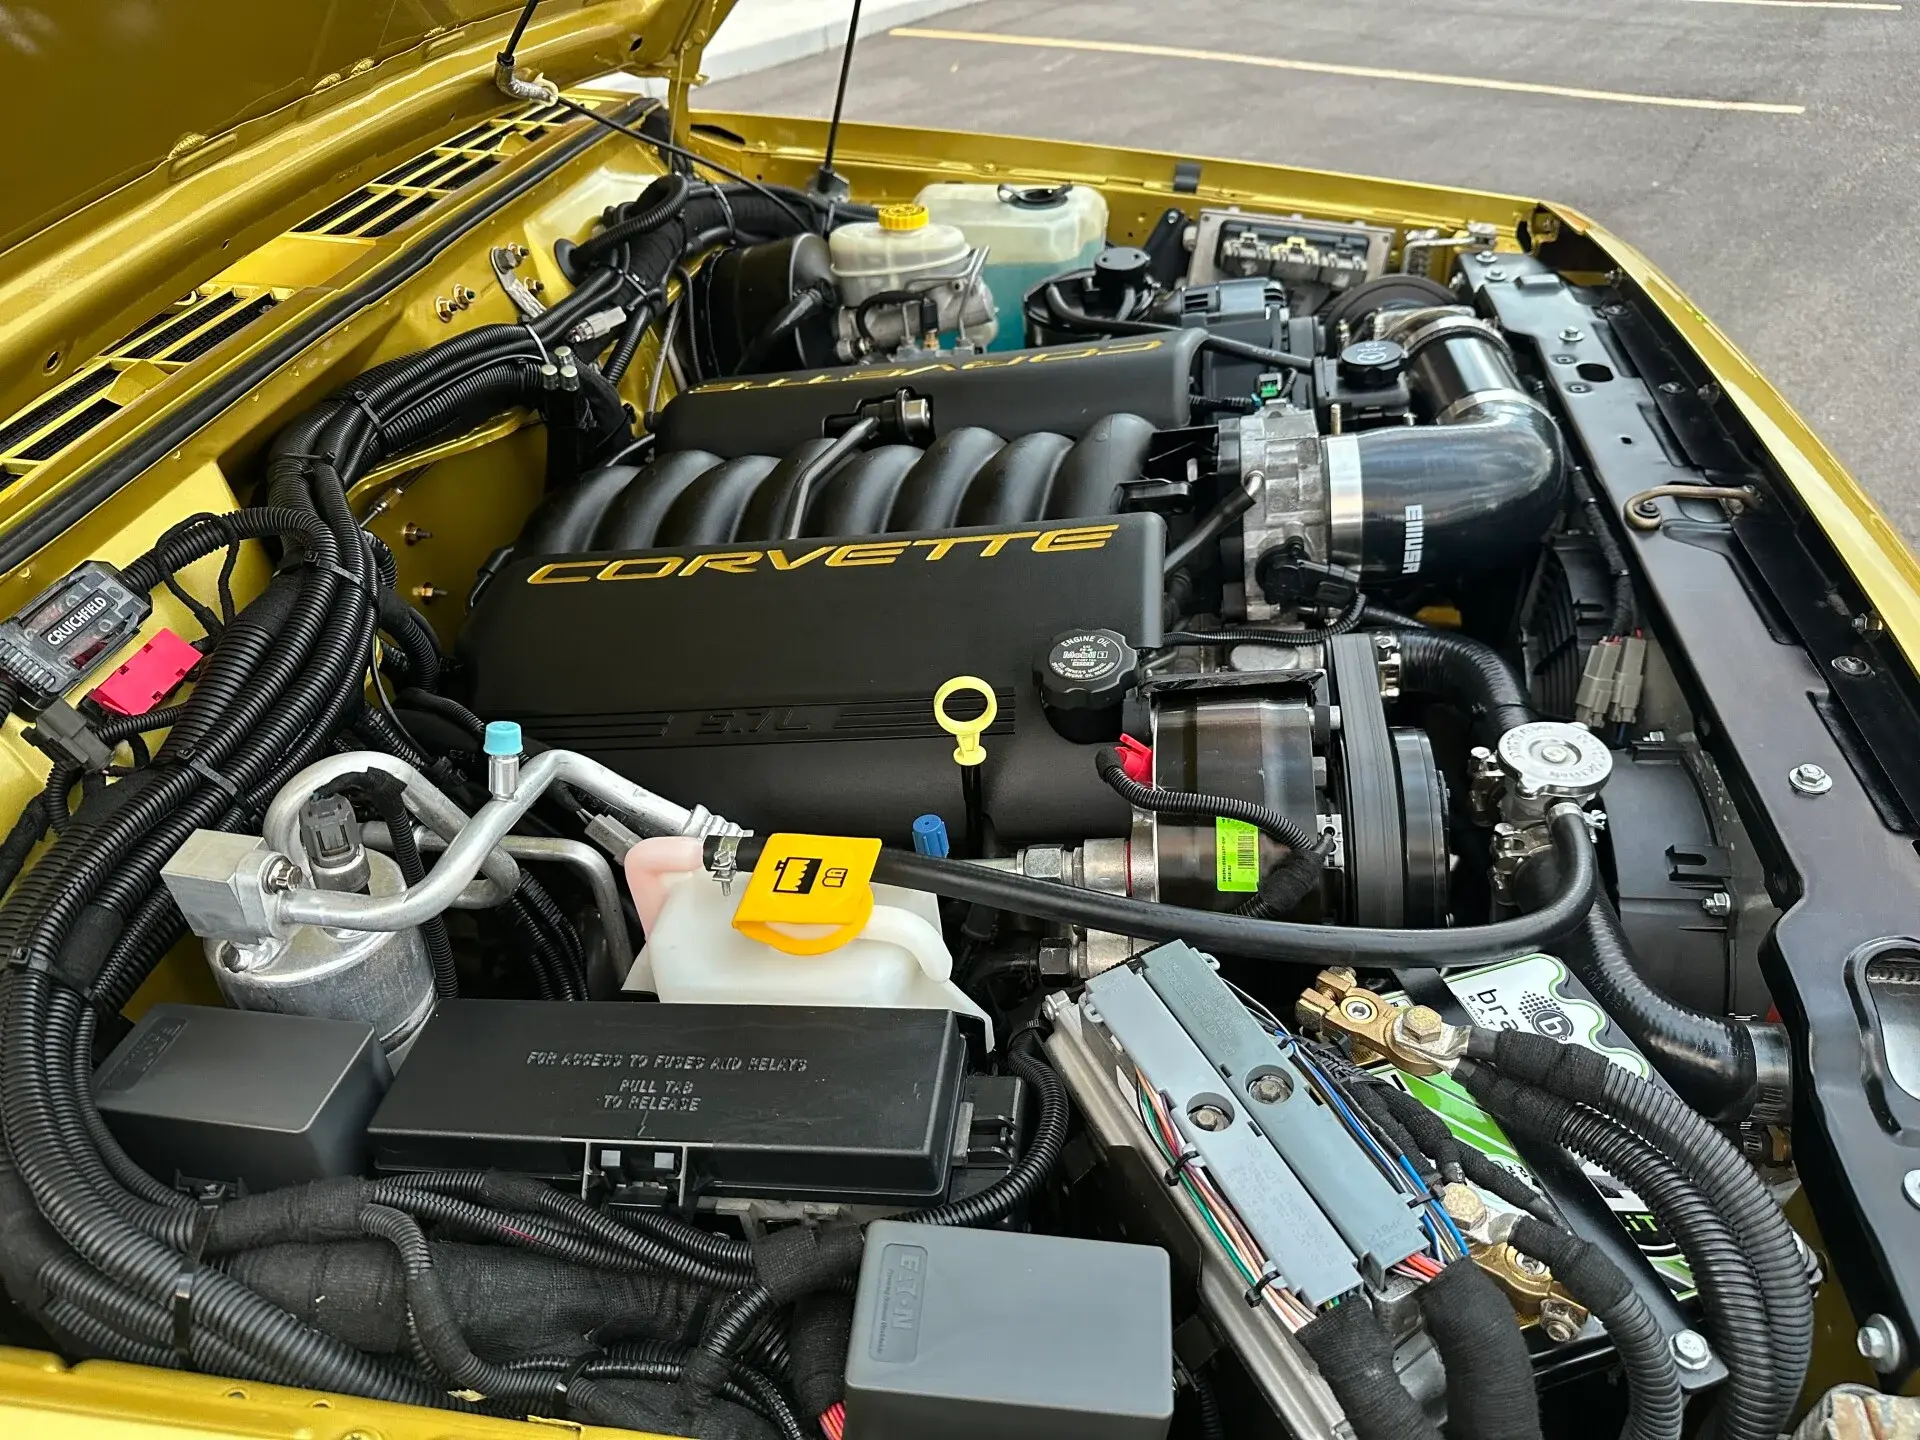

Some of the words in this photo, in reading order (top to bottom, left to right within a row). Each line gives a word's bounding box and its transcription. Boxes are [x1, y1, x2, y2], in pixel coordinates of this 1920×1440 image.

[526, 524, 1119, 585] CORVETTE
[47, 596, 107, 645] CRUTCHFIELD
[1060, 635, 1096, 647] ENGINE
[1096, 638, 1111, 647] OIL
[1063, 651, 1096, 659] Mobil
[696, 709, 810, 734] 5.7L
[526, 1051, 558, 1065] FOR
[560, 1052, 623, 1068] ACCESS
[629, 1054, 649, 1068] TO
[654, 1055, 706, 1070] FUSES
[710, 1056, 742, 1072] AND
[747, 1057, 808, 1072] RELAYS
[619, 1079, 657, 1094] PULL
[665, 1080, 695, 1095] TAB
[603, 1094, 623, 1109] TO
[628, 1096, 702, 1111] RELEASE
